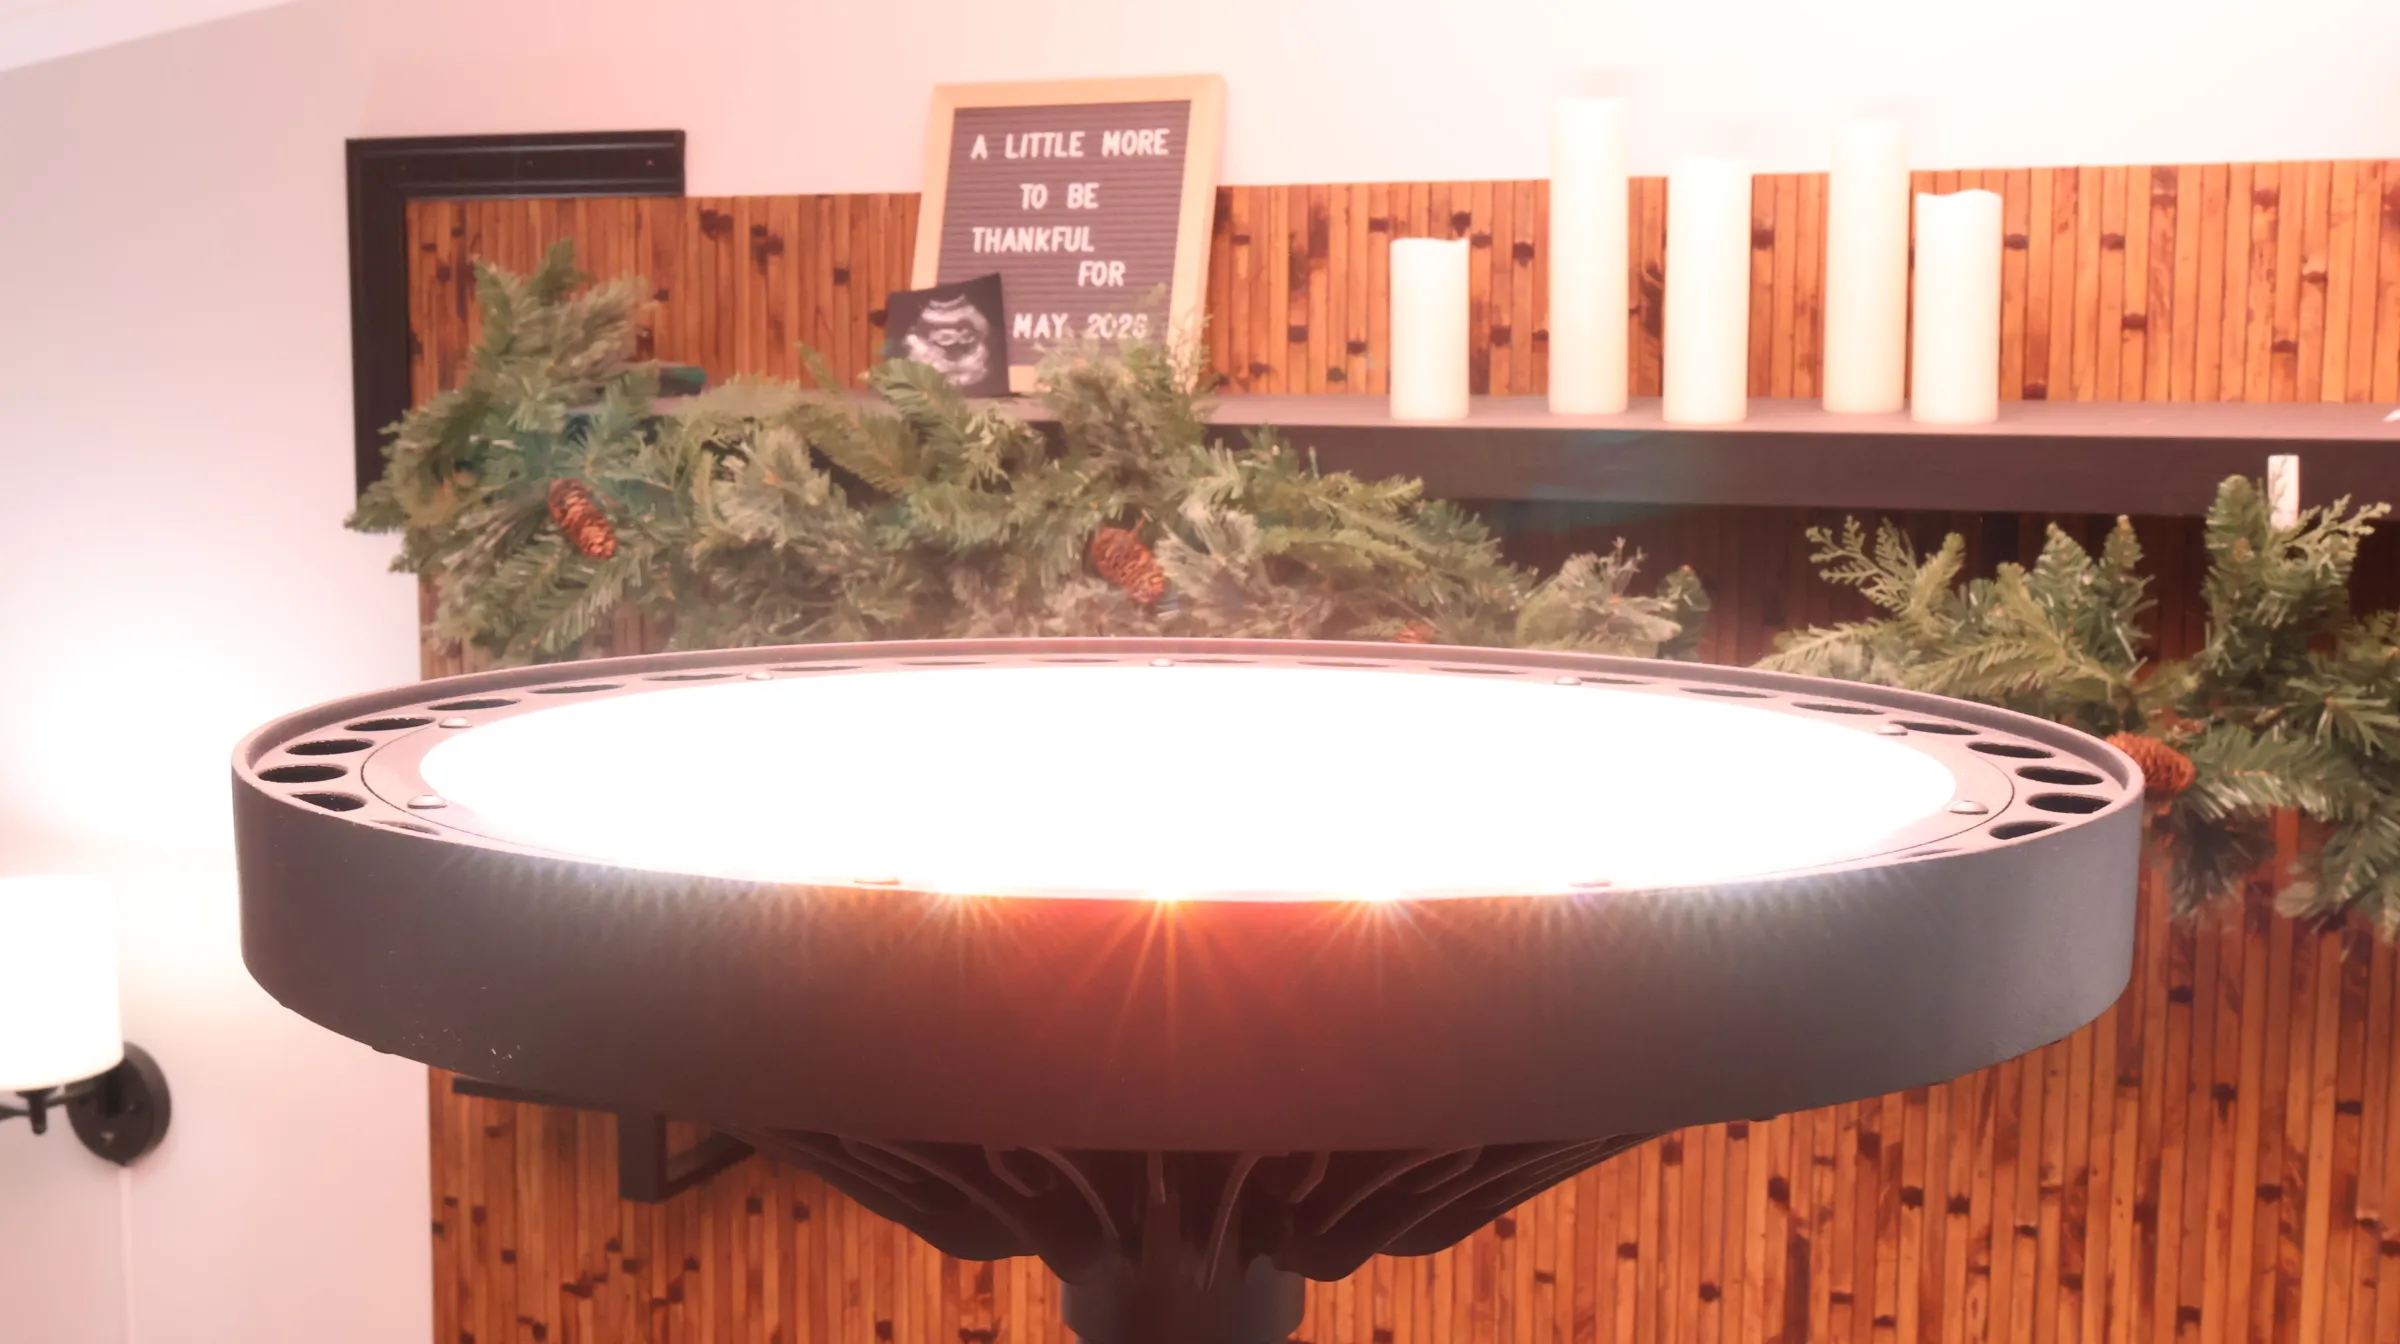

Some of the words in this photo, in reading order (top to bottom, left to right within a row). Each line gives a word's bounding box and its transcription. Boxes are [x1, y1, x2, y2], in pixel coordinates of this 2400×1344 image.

[971, 134, 988, 159] A
[1005, 131, 1085, 158] LITTLE
[1102, 128, 1170, 156] MORE
[1020, 183, 1048, 210] TO
[1067, 183, 1099, 209] BE
[972, 226, 1095, 252] THANKFUL
[1077, 261, 1126, 286] FOR
[1012, 313, 1068, 339] MAY
